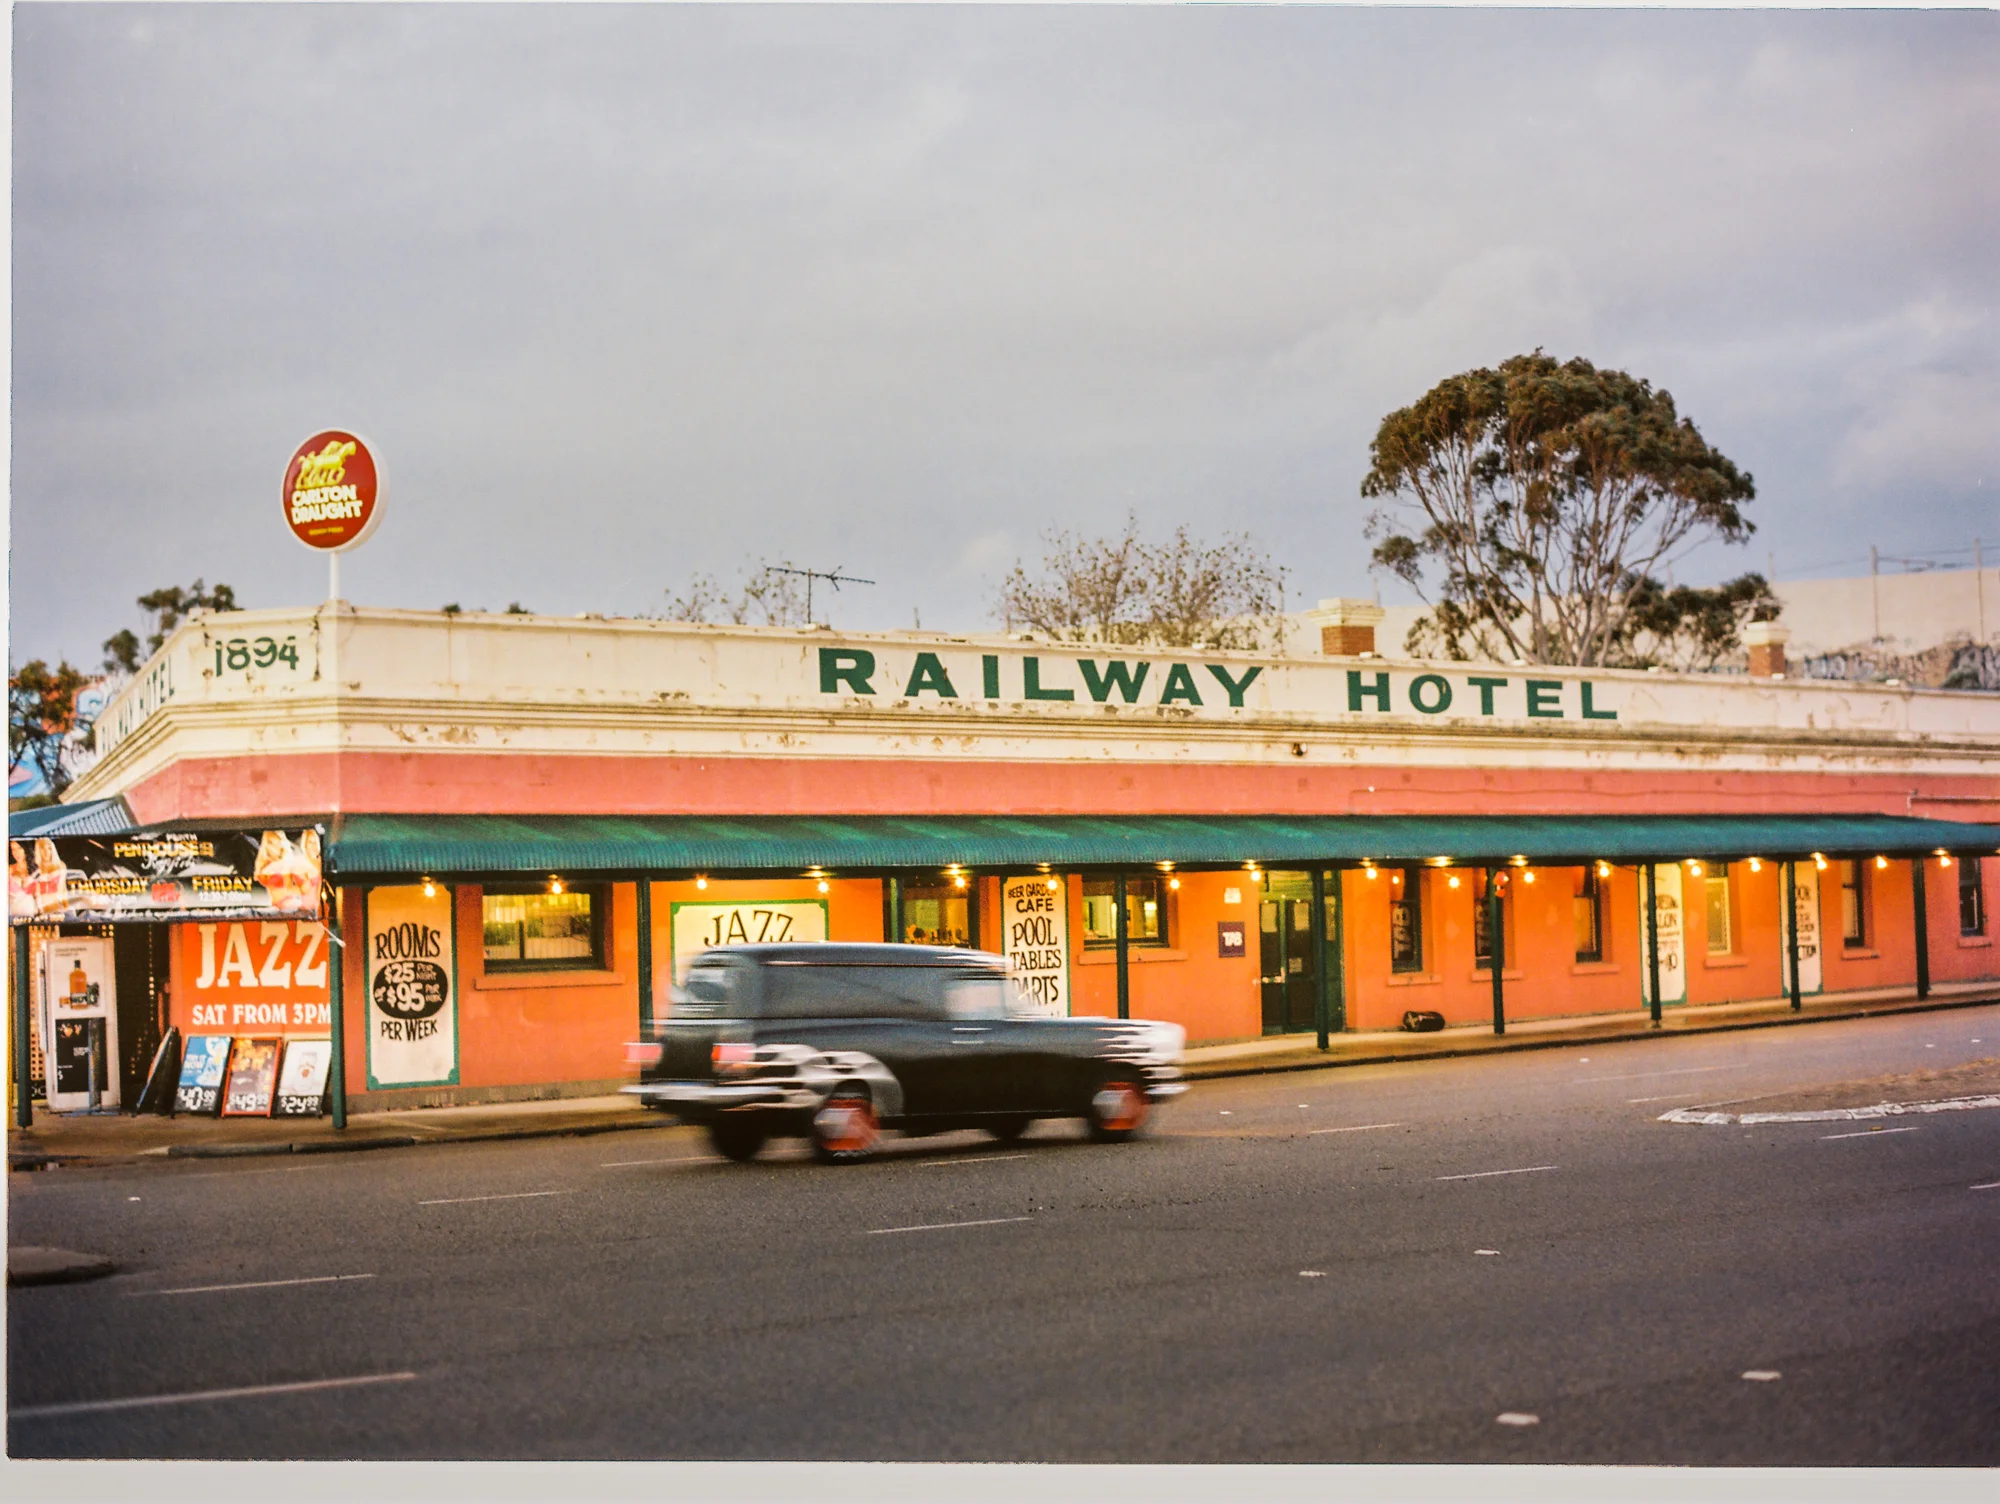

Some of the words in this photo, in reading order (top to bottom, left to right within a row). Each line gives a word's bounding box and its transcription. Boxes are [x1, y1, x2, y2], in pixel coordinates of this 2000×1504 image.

[292, 484, 357, 507] CARLTON
[291, 500, 363, 525] DRAUGHT
[215, 636, 299, 677] 1894
[818, 646, 1263, 709] RAILWAY
[1347, 669, 1618, 720] HOTEL
[67, 878, 149, 895] THURSDAY
[192, 876, 253, 892] FRIDAY
[1008, 885, 1025, 898] BEER
[1016, 898, 1054, 913] CAFE
[703, 909, 794, 947] JAZZ
[1012, 916, 1058, 947] POOL
[1222, 931, 1243, 947] TAB
[374, 922, 441, 959] ROOMS
[195, 921, 328, 990] JAZZ
[1010, 949, 1062, 971] TABLES
[384, 962, 416, 984] $25
[387, 982, 425, 1012] $95
[192, 1004, 227, 1026] SAT
[233, 1004, 287, 1026] FROM
[293, 1003, 331, 1025] 3PM
[381, 1021, 402, 1041] PER
[405, 1018, 438, 1041] WEEK
